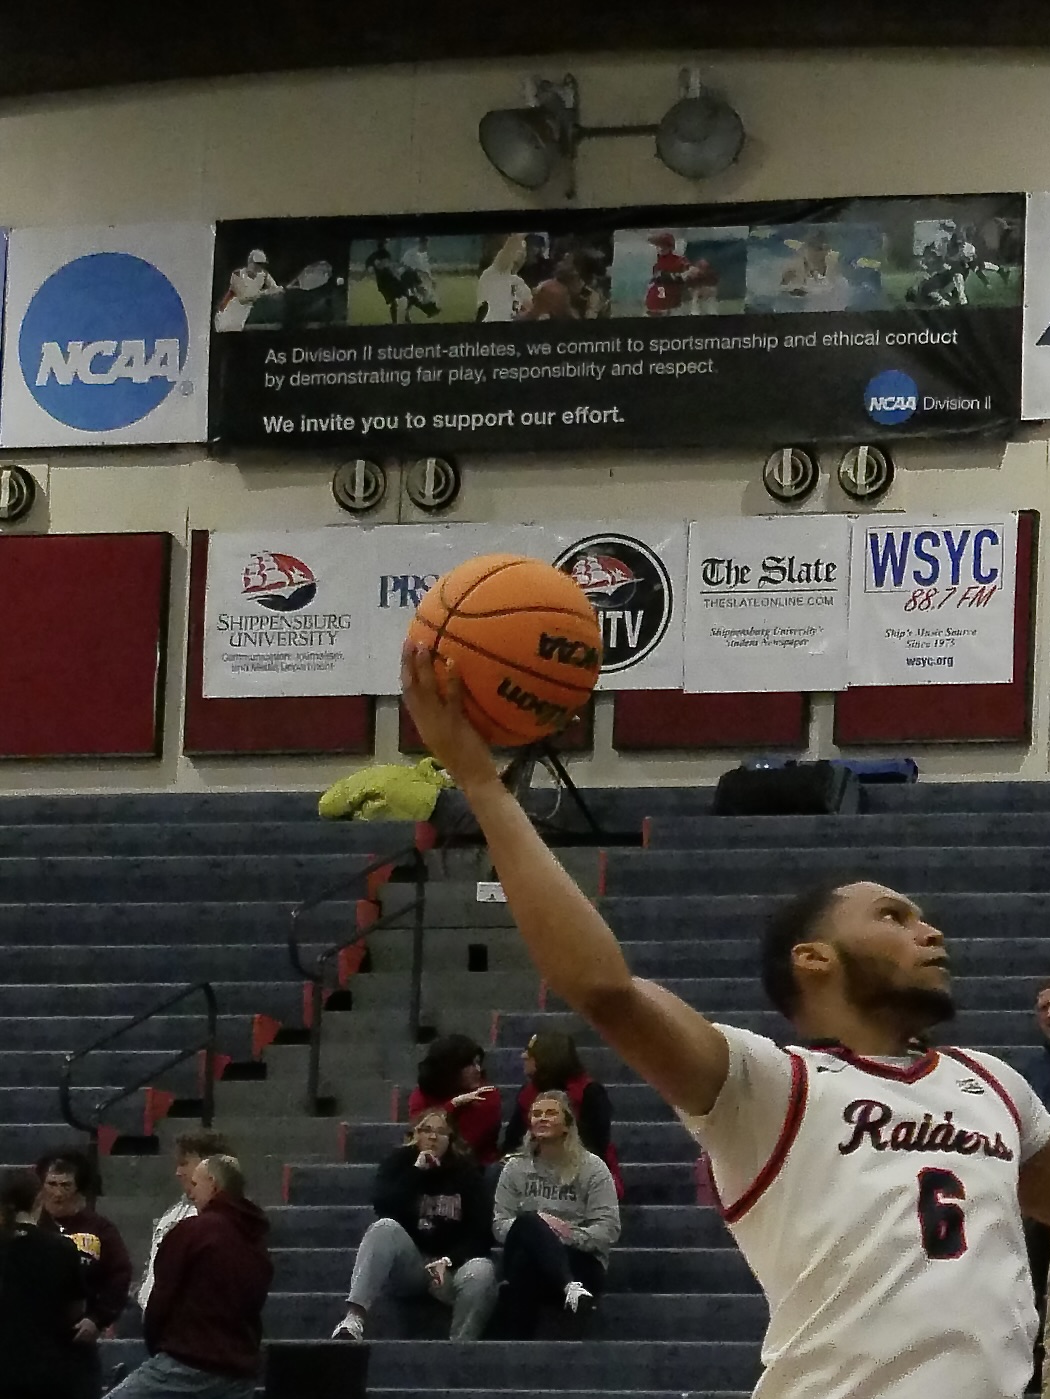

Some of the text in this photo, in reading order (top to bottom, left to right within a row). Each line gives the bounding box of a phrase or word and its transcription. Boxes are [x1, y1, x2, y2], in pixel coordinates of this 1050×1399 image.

[264, 348, 287, 365] As
[292, 347, 357, 364] Division
[527, 344, 551, 356] we
[557, 338, 621, 354] commit
[627, 338, 644, 353] to
[649, 333, 779, 355] sportsmanship
[784, 331, 817, 348] and
[822, 330, 880, 347] ethical
[885, 329, 959, 346] conduct
[35, 339, 181, 387] NCAA
[264, 373, 285, 391] by
[289, 369, 411, 387] demonstrating
[416, 366, 443, 383] fair
[448, 366, 487, 385] play,
[492, 363, 606, 383] responsibility
[611, 360, 643, 376] and
[869, 396, 917, 412] NCAA
[923, 396, 981, 411] Division
[263, 406, 625, 435] We invite you to support our effort.
[701, 556, 838, 589] The Slate
[868, 529, 1000, 588] WSYC
[904, 585, 998, 612] 88.7 FM
[217, 614, 351, 632] SHIPPENSBURG
[229, 630, 339, 647] UNIVERSITY
[906, 656, 954, 668] wsyc.org
[838, 1099, 1014, 1162] Raiders
[917, 1166, 968, 1260] 6
